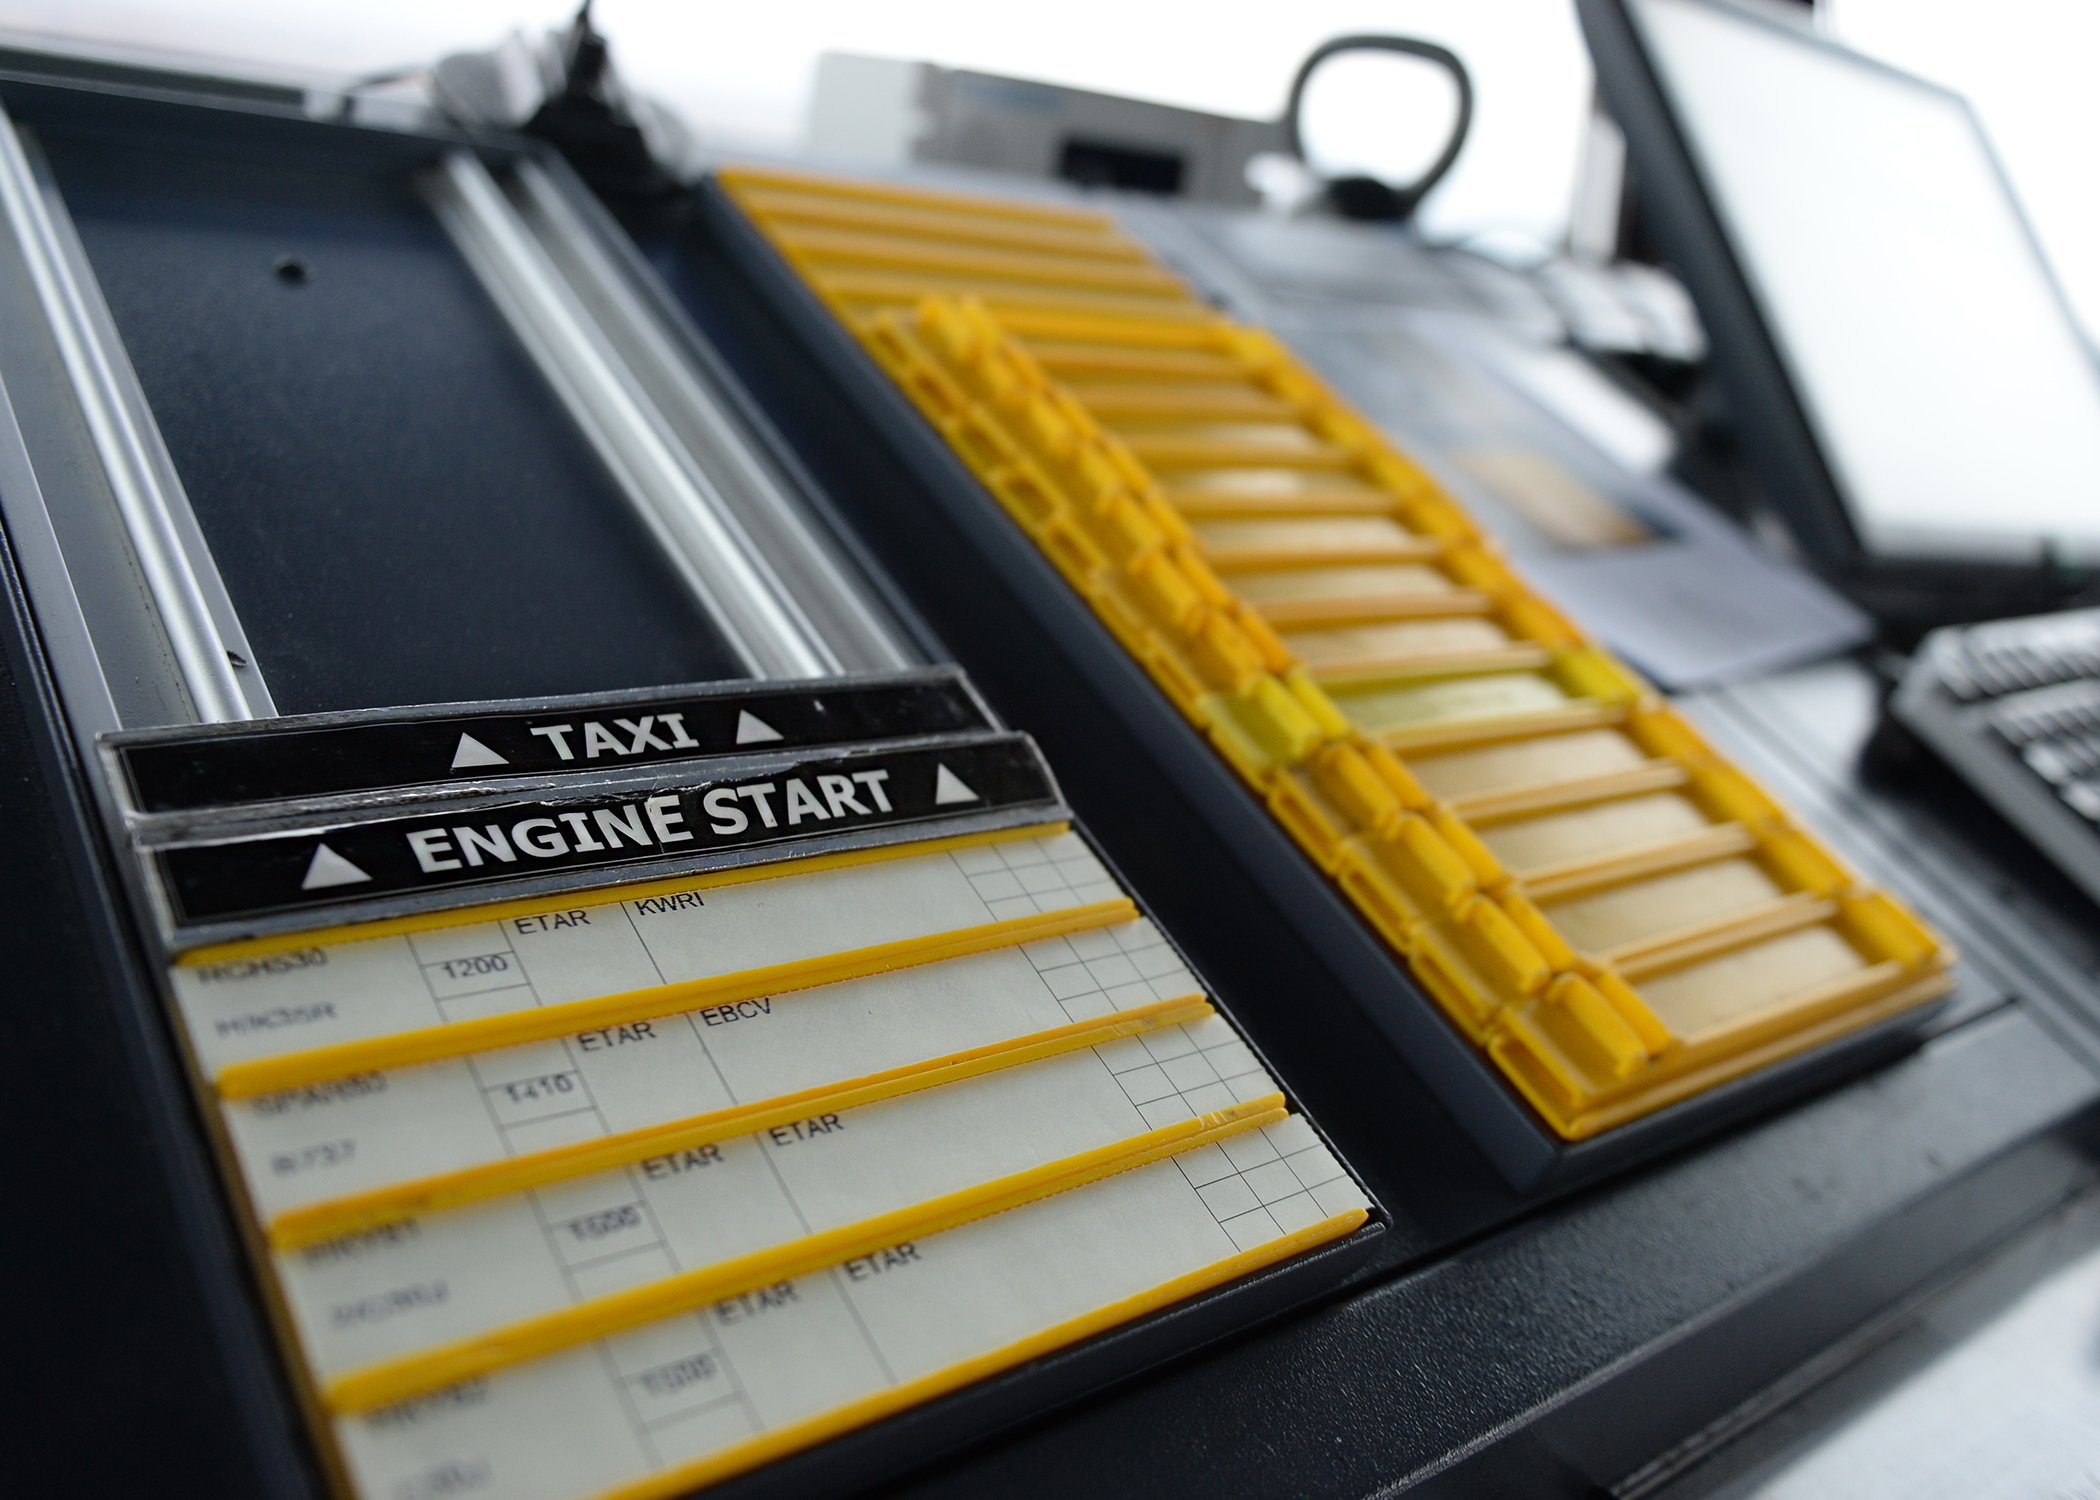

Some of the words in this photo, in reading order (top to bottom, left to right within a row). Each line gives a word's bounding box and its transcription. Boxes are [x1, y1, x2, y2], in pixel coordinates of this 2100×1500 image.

[531, 712, 699, 761] TAXI
[406, 794, 693, 874] ENGINE
[703, 769, 891, 835] START
[634, 891, 705, 916] KWRI
[514, 909, 591, 935] ETAR
[442, 955, 509, 979] 1200
[700, 997, 772, 1027] EBCV
[576, 1021, 657, 1052] ETAR
[506, 1075, 574, 1104] 1410
[769, 1113, 845, 1147] ETAR
[643, 1143, 725, 1181] ETAR
[843, 1241, 922, 1282] ETAR
[714, 1279, 800, 1325] ETAR
